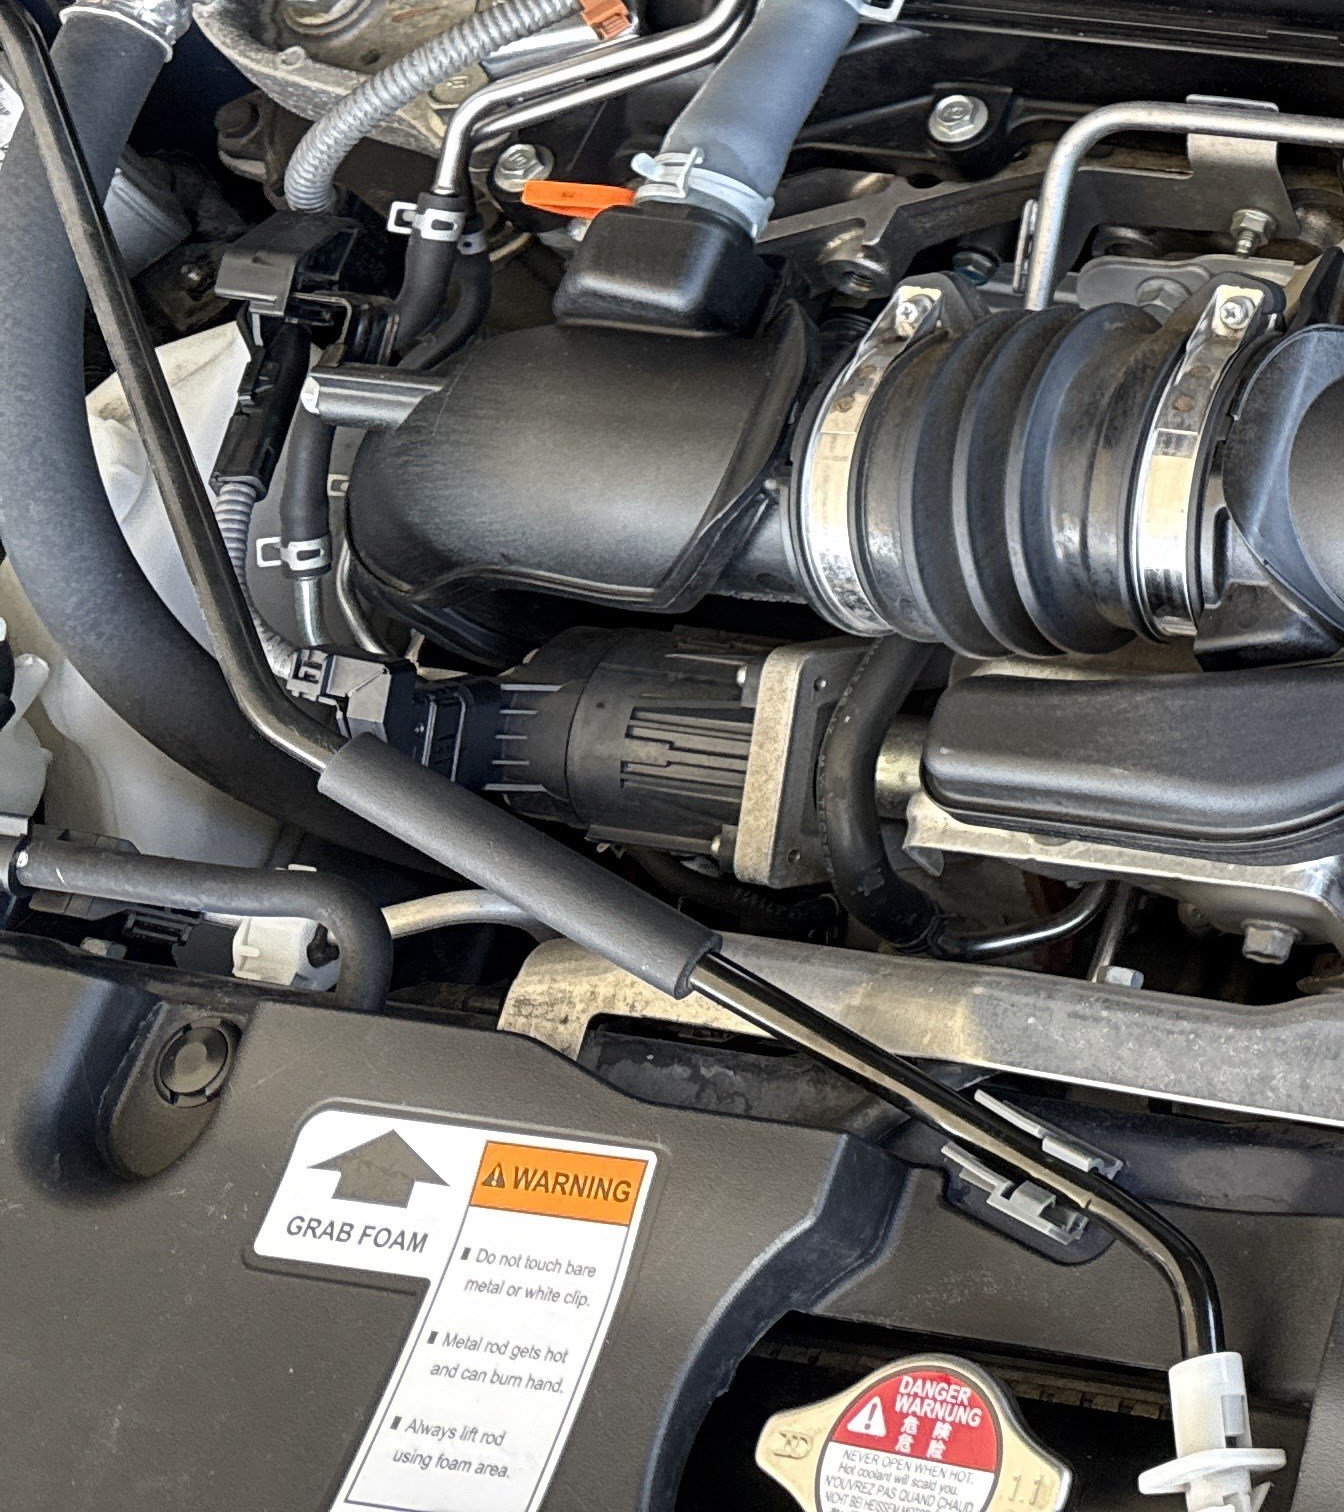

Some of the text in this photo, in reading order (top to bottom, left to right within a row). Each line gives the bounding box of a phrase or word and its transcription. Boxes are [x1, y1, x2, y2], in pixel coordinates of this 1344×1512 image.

[512, 1166, 632, 1203] WARNING
[286, 1215, 429, 1254] GRAB FOAM
[476, 1248, 596, 1277] Do not touch bare
[463, 1278, 590, 1308] metal or white clip.
[442, 1332, 569, 1364] Metal rod gets hot
[430, 1363, 564, 1394] and can burn hand.
[899, 1375, 972, 1406] DANGER
[894, 1393, 982, 1427] WARNUNG
[404, 1418, 506, 1447] Always lift rod
[392, 1449, 511, 1479] using foam area.
[838, 1462, 856, 1475] Hot
[857, 1468, 892, 1483] coolant
[894, 1474, 909, 1485] will
[911, 1478, 937, 1491] scald
[842, 1449, 880, 1465] NEVER
[882, 1456, 912, 1472] OPEN
[914, 1463, 947, 1479] WHEN
[876, 1485, 897, 1499] PAS
[899, 1489, 935, 1507] QUAND
